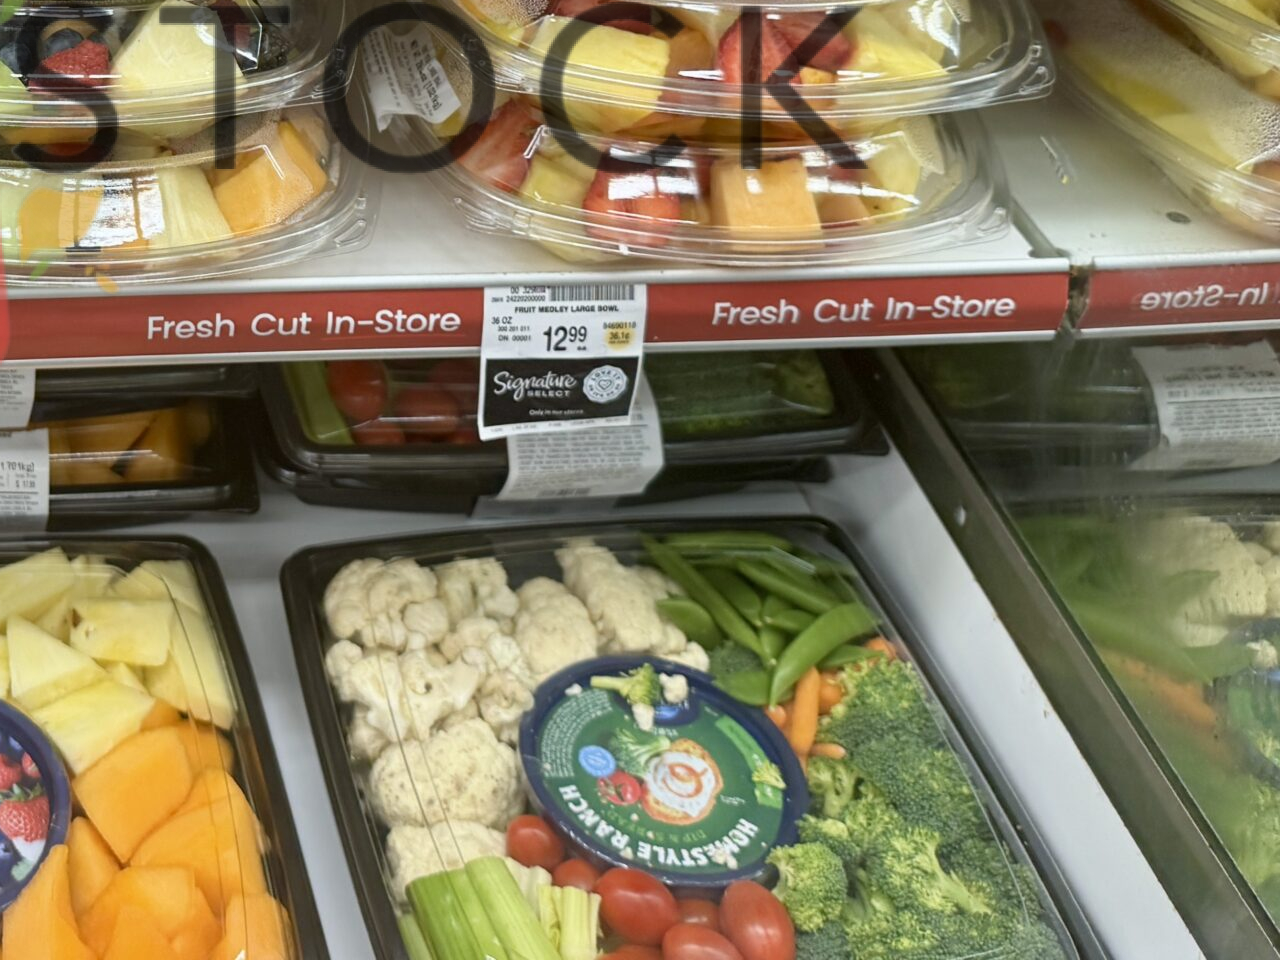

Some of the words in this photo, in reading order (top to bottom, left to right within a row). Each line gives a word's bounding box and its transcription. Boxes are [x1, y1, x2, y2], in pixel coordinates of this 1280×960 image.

[147, 313, 235, 340] Fresh
[251, 312, 312, 336] Cut
[326, 309, 461, 335] In-Store
[502, 316, 513, 324] OZ
[712, 299, 799, 325] Fresh
[813, 298, 873, 323] Cut
[885, 295, 1016, 321] In-Store
[493, 370, 577, 402] Signature
[559, 784, 630, 851] RANCH
